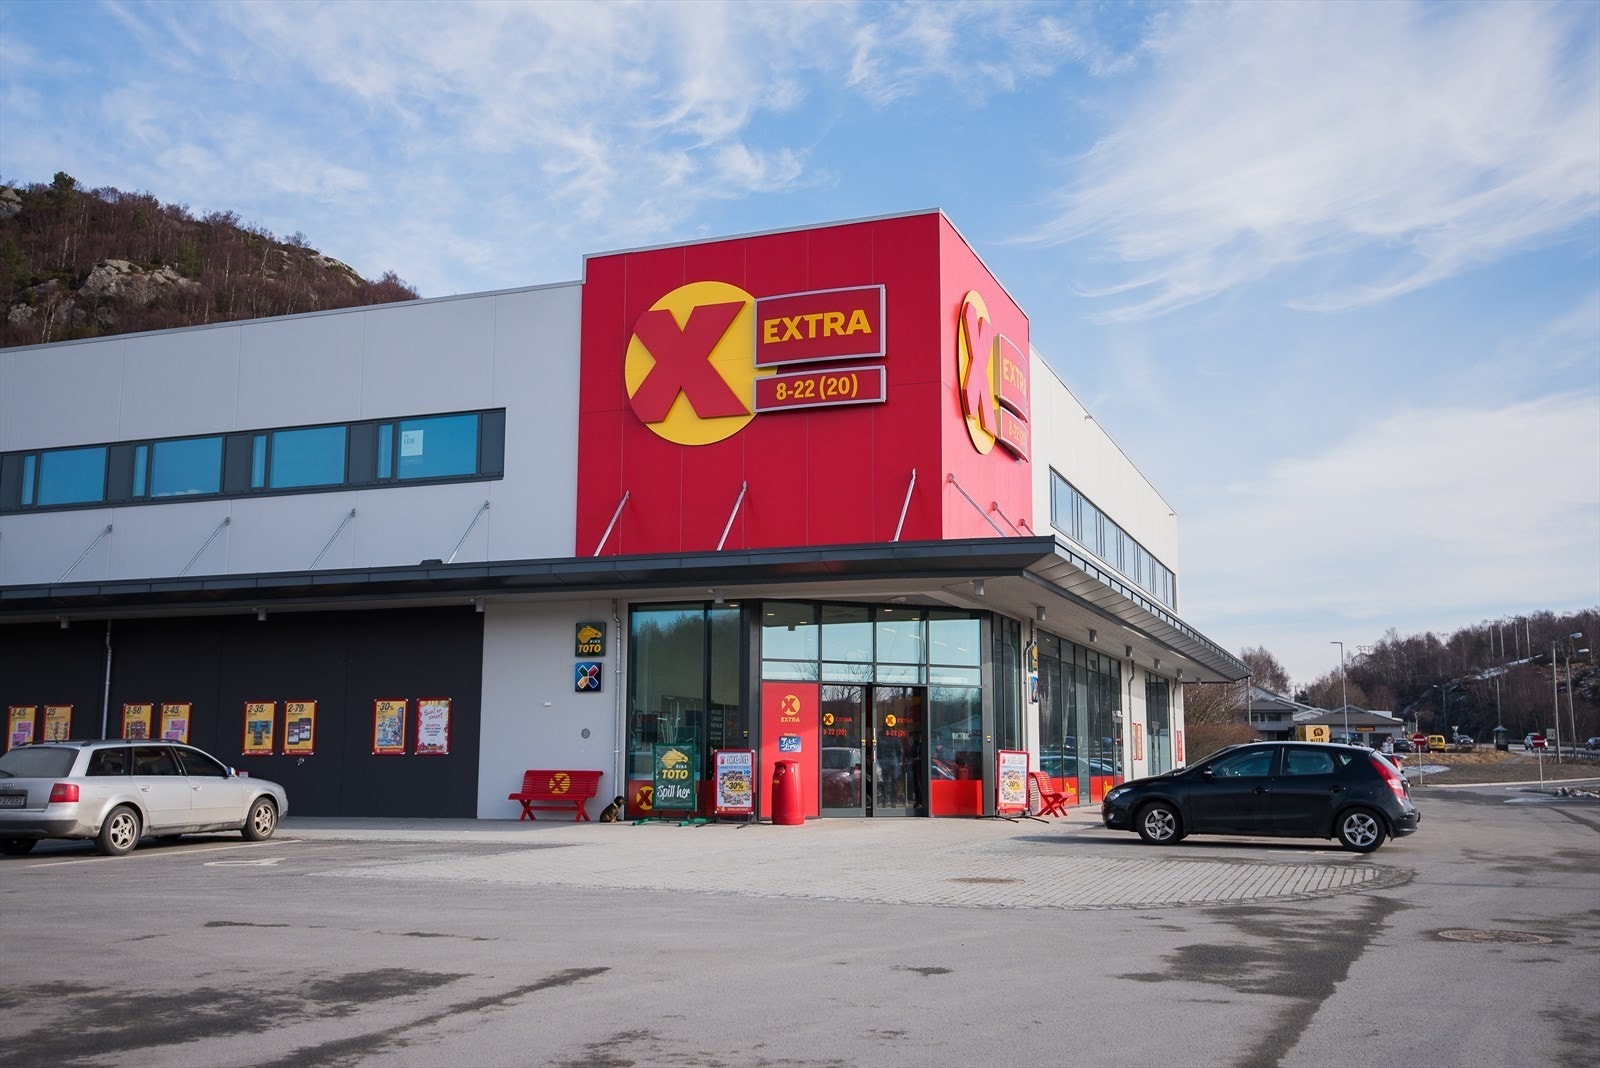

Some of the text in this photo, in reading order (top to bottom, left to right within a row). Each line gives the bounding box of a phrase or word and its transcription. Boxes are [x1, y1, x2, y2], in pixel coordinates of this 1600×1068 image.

[764, 309, 872, 344] EXTRA
[776, 374, 858, 401] 8-22 (20)
[578, 644, 602, 653] TOTO
[662, 769, 689, 779] TOTO
[726, 781, 744, 790] -30%
[657, 785, 691, 800] Spill her
